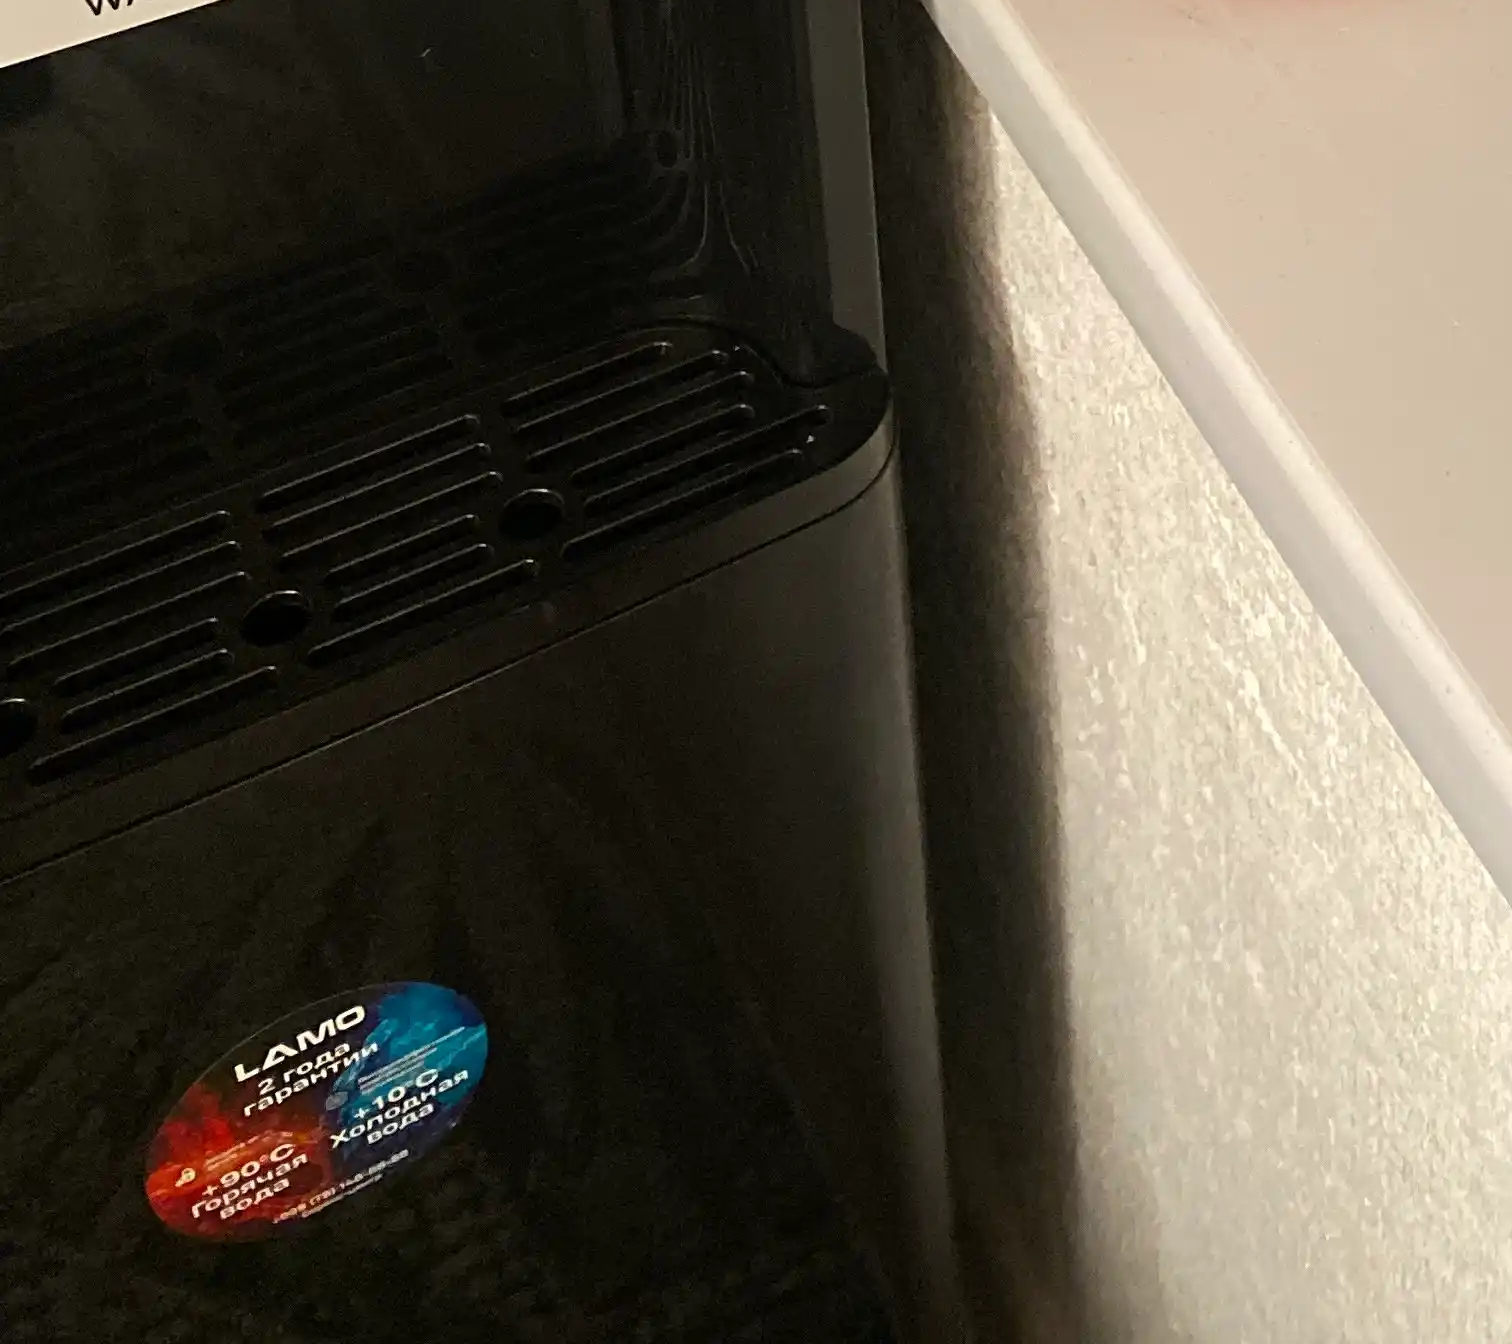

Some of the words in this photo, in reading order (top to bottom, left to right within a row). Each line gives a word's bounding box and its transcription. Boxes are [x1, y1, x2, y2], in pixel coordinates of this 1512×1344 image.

[234, 1005, 366, 1082] LAMO
[258, 1077, 275, 1095] 2
[283, 1043, 350, 1083] года
[243, 1042, 378, 1117] гарантии
[330, 1070, 469, 1148] Холодная
[366, 1093, 434, 1144] вода
[192, 1154, 308, 1218] Горячая
[220, 1178, 290, 1219] вода
